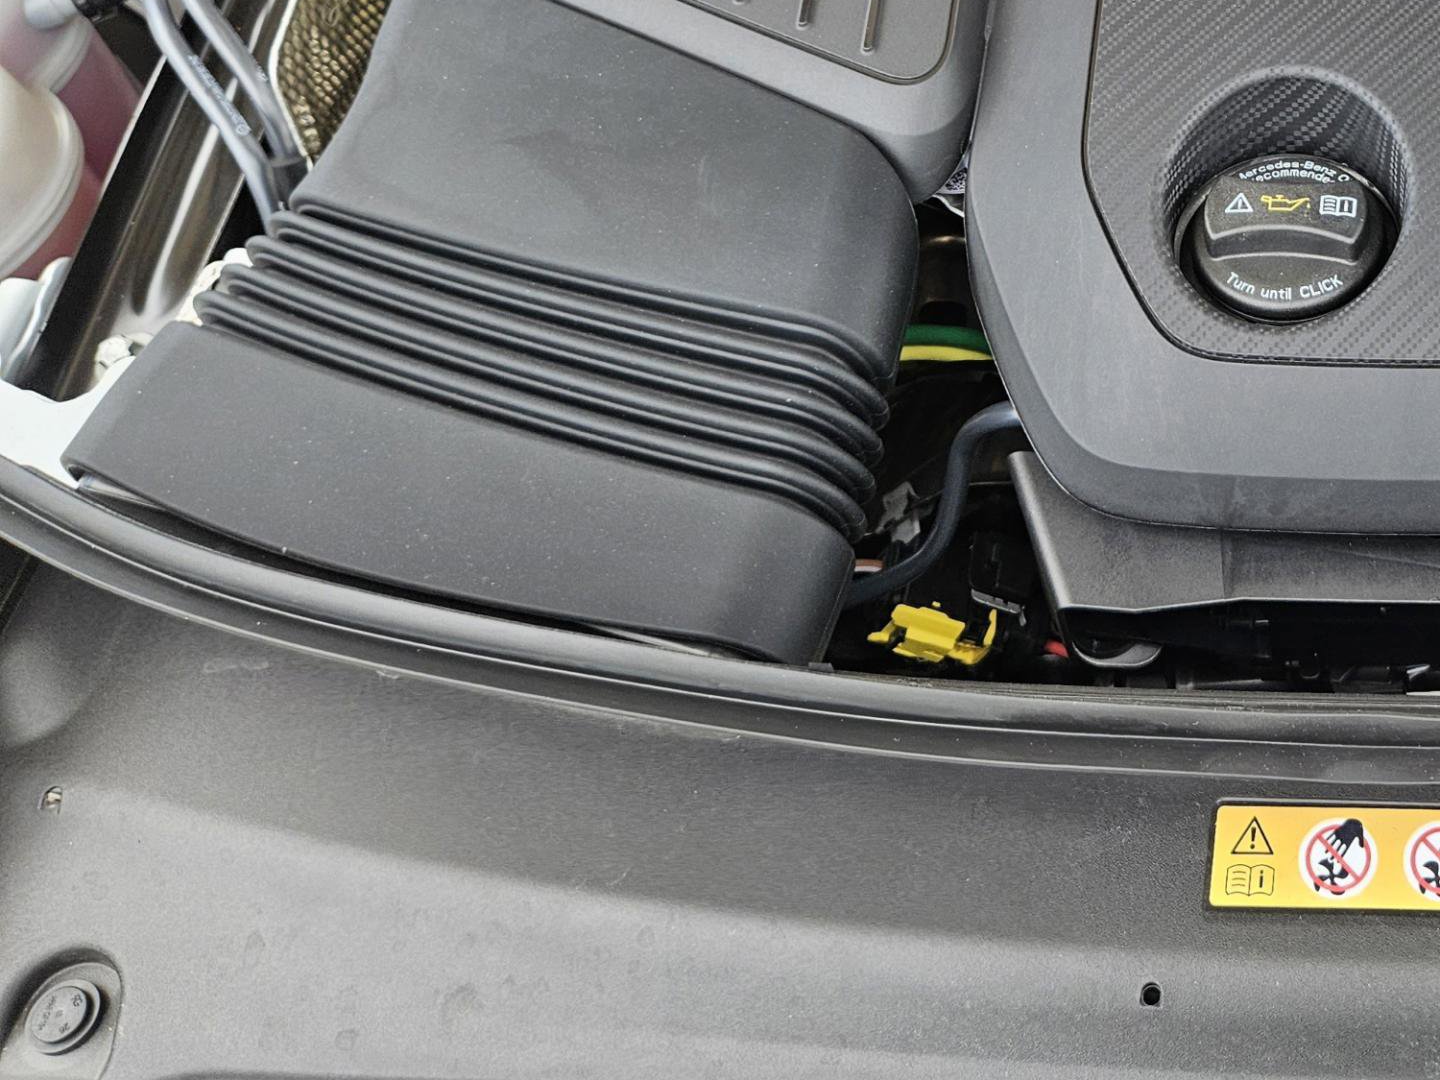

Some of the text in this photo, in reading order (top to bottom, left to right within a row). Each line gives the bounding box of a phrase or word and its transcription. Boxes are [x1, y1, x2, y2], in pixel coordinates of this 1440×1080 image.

[1252, 168, 1335, 184] ecommende
[1226, 271, 1344, 300] Turn until CLICK
